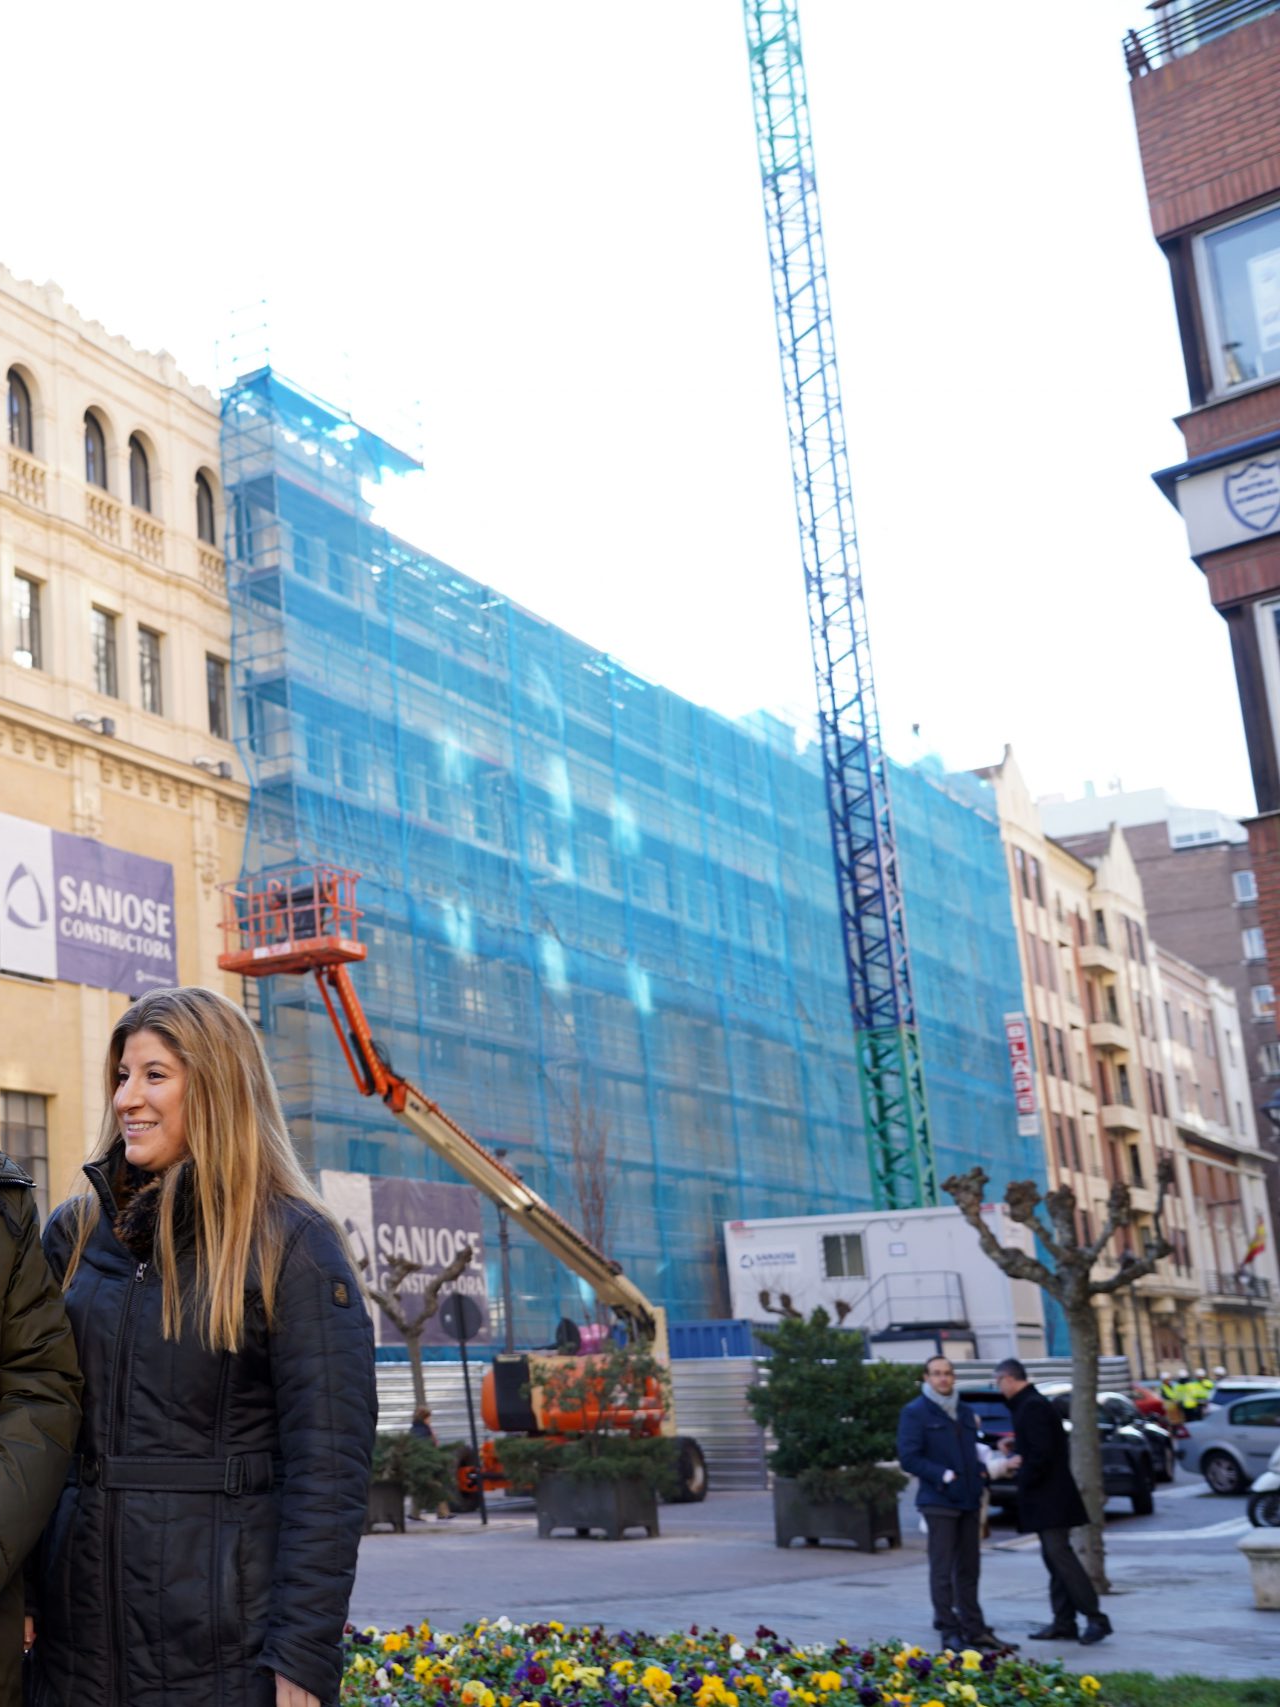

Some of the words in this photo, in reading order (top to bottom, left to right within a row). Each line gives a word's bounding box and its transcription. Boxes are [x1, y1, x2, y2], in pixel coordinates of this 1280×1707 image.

[59, 875, 171, 938] SANJOSE
[60, 917, 172, 961] CONSTRUCTORA
[1006, 1025, 1033, 1110] BLAPE
[378, 1223, 482, 1269] SANJOSE
